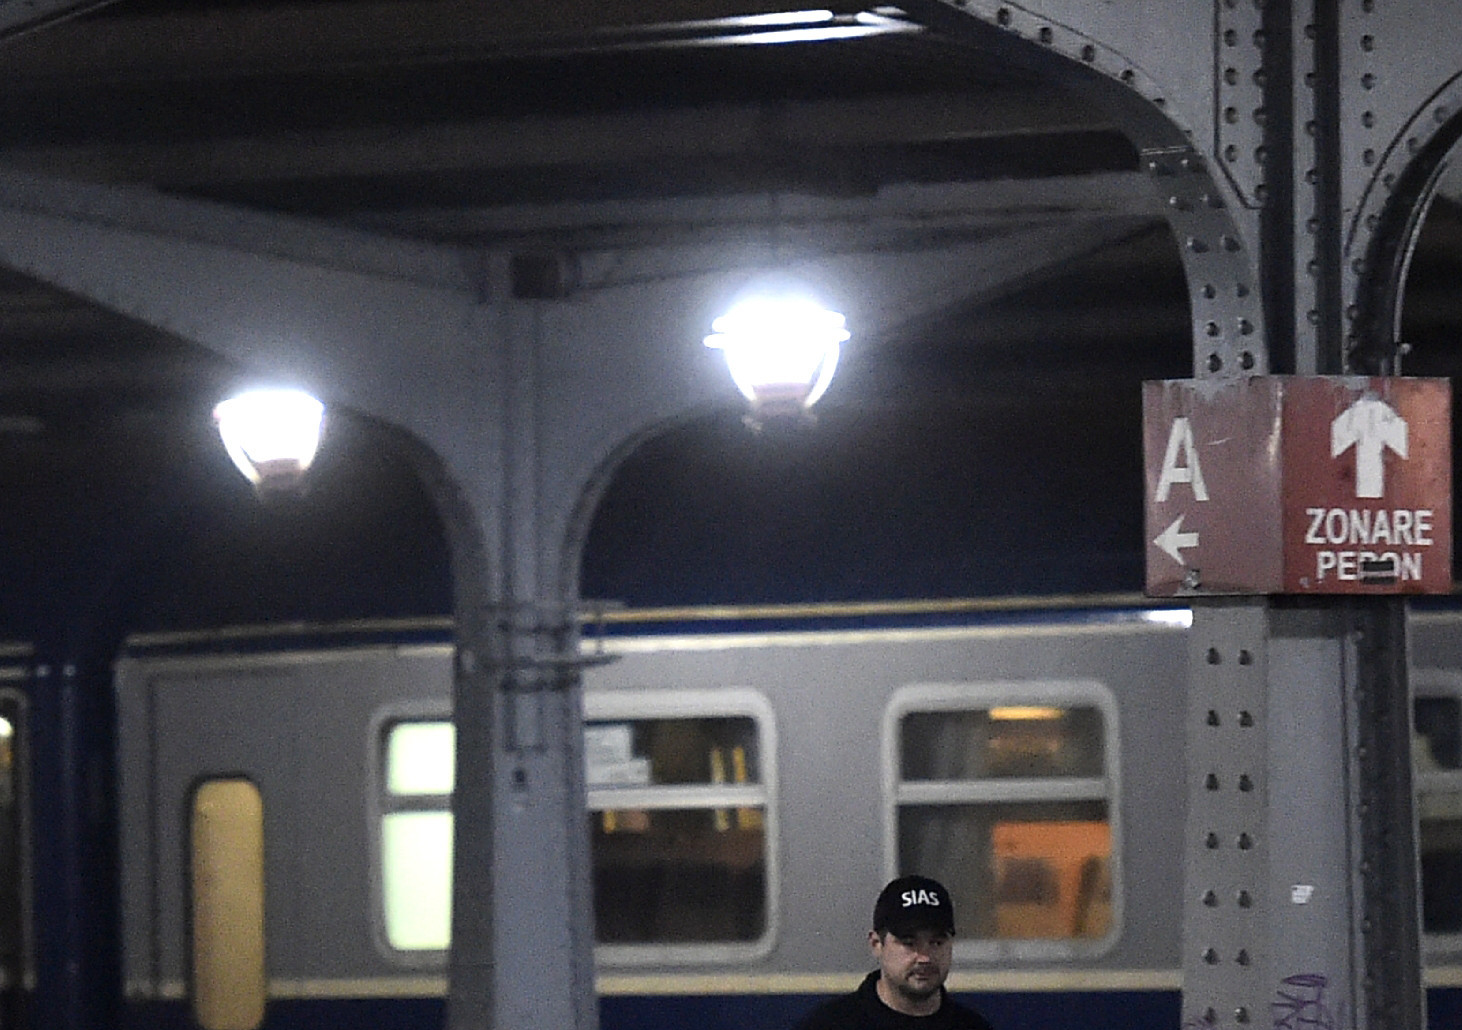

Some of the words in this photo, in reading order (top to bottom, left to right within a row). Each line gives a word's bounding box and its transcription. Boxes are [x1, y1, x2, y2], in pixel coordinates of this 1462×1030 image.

[1154, 416, 1210, 502] A
[1305, 507, 1434, 546] ZONARE
[901, 889, 940, 908] SIAS
